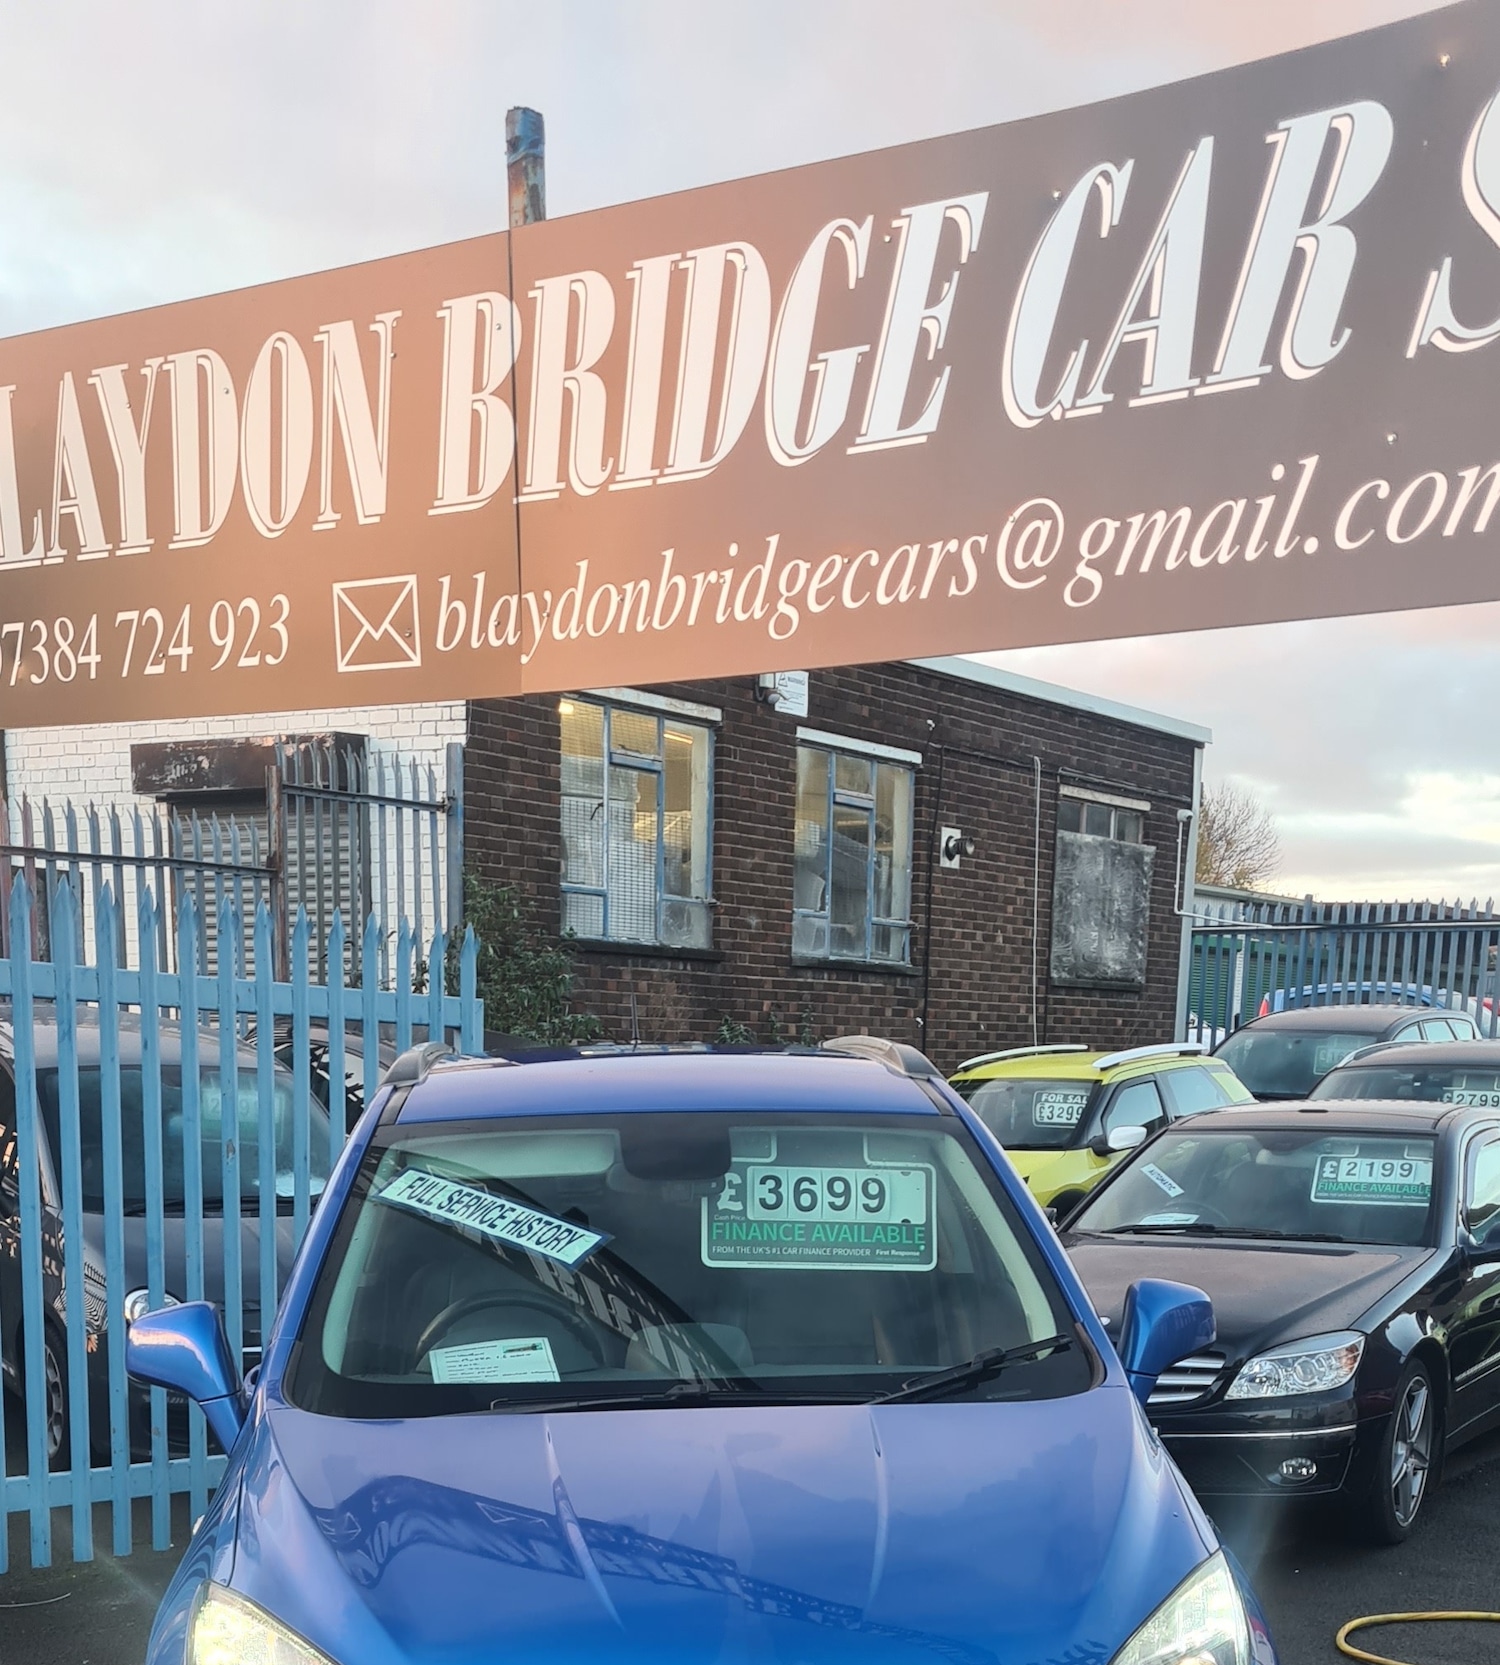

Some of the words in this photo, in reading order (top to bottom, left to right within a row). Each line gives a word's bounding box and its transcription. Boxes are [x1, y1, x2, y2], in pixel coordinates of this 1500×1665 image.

[0, 311, 402, 571] LAYDON
[428, 191, 989, 516] BRIDGE
[1001, 100, 1394, 429] CAR
[0, 614, 101, 686] 7384
[115, 603, 193, 677] 724
[209, 594, 290, 671] 923
[434, 455, 1500, 665] blaydonbridgecars@gmail.com
[1041, 1093, 1064, 1102] FOR
[1066, 1095, 1088, 1104] SAL
[1038, 1102, 1084, 1121] £3299
[1322, 1160, 1413, 1178] £2199
[717, 1172, 887, 1214] £3699
[1317, 1182, 1368, 1191] FINANCE
[1369, 1184, 1432, 1194] AVAILABLE
[397, 1176, 448, 1206] FULL
[436, 1188, 511, 1230] SERVICE
[500, 1208, 586, 1253] HISTORY
[714, 1214, 730, 1222] Cash
[711, 1222, 806, 1242] FINANCE
[811, 1224, 926, 1244] AVAILABLE
[712, 1245, 735, 1254] FROM
[735, 1246, 752, 1254] THE
[752, 1246, 771, 1255] UK'S
[771, 1247, 781, 1255] #1
[782, 1247, 798, 1255] CAR
[798, 1248, 832, 1256] FINANCE
[833, 1248, 871, 1257] PROVIDER
[875, 1248, 890, 1256] First
[890, 1249, 921, 1257] Response
